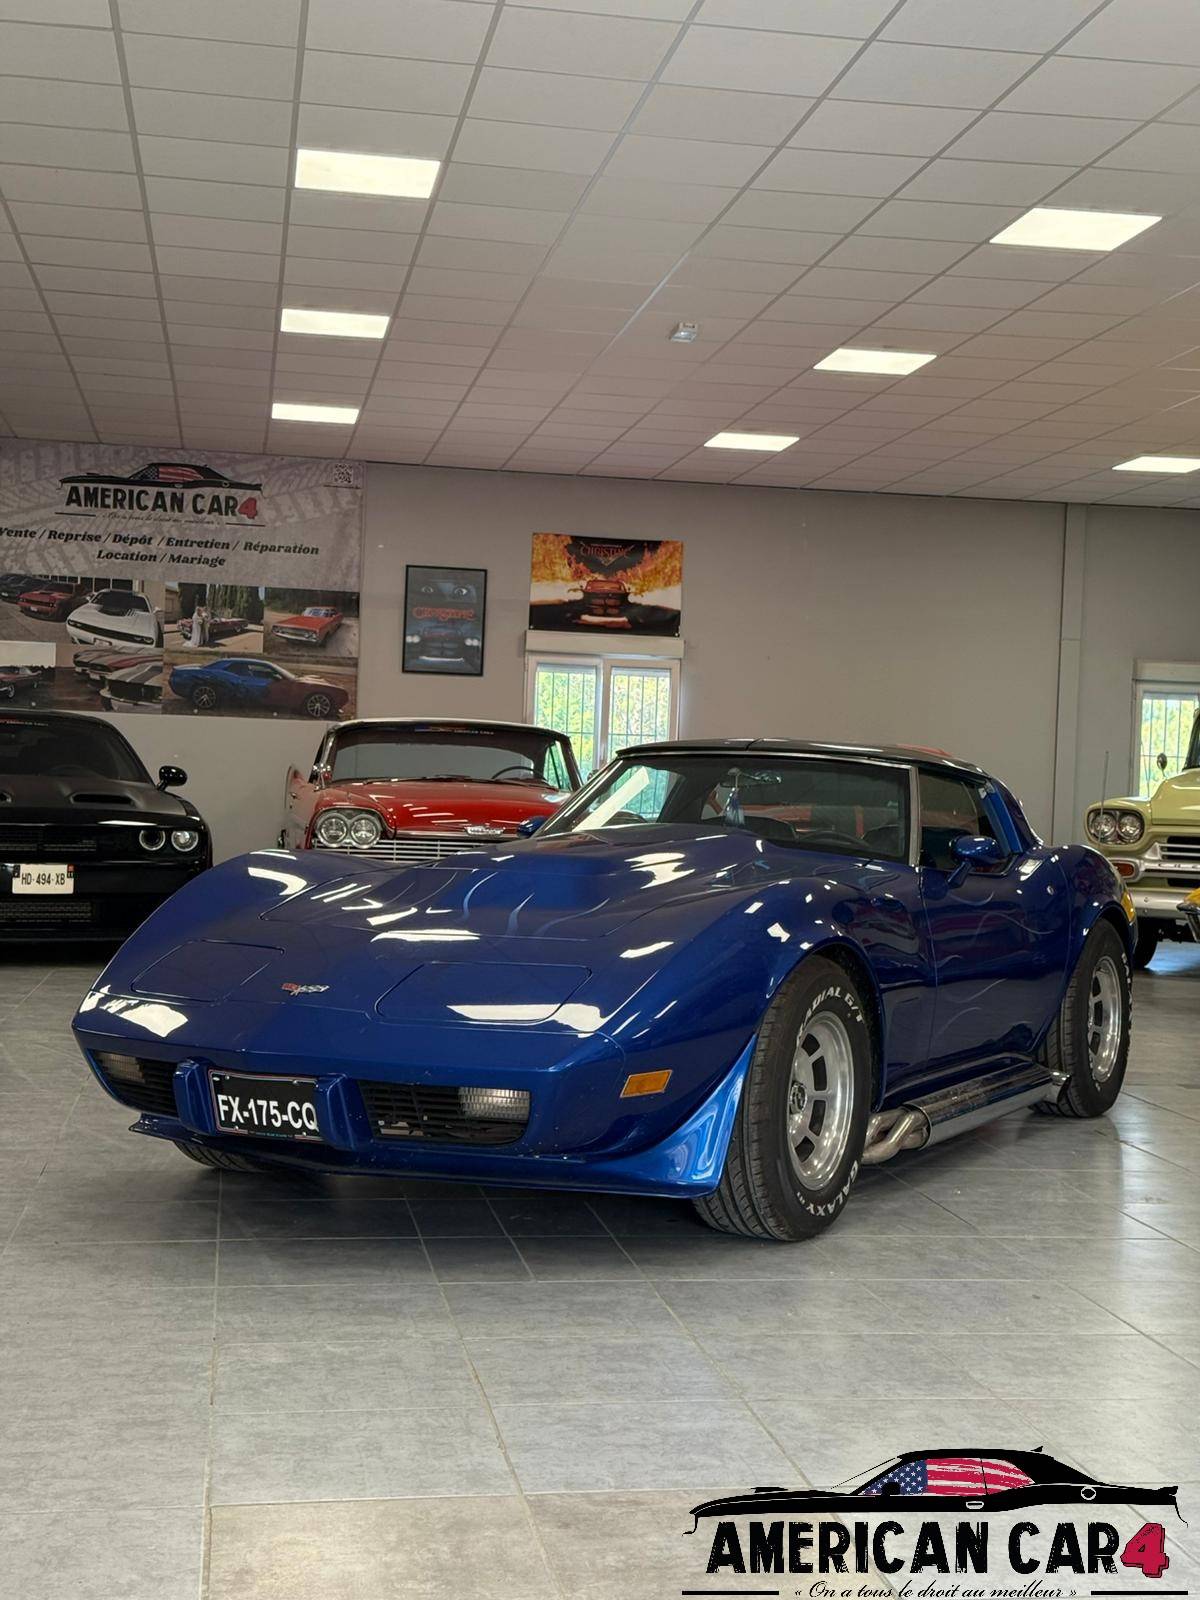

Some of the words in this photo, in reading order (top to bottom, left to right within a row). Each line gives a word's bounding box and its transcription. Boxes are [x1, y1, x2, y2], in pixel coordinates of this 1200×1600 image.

[65, 485, 184, 513] AMERICAN
[47, 530, 102, 543] Reprise
[112, 533, 153, 547] Dépôt
[165, 537, 231, 550] Entretien
[243, 541, 320, 555] Réparation
[96, 549, 158, 562] Location
[167, 553, 227, 568] Mariage
[217, 1094, 320, 1132] FX-175-CQ
[805, 1159, 859, 1217] GALAXY
